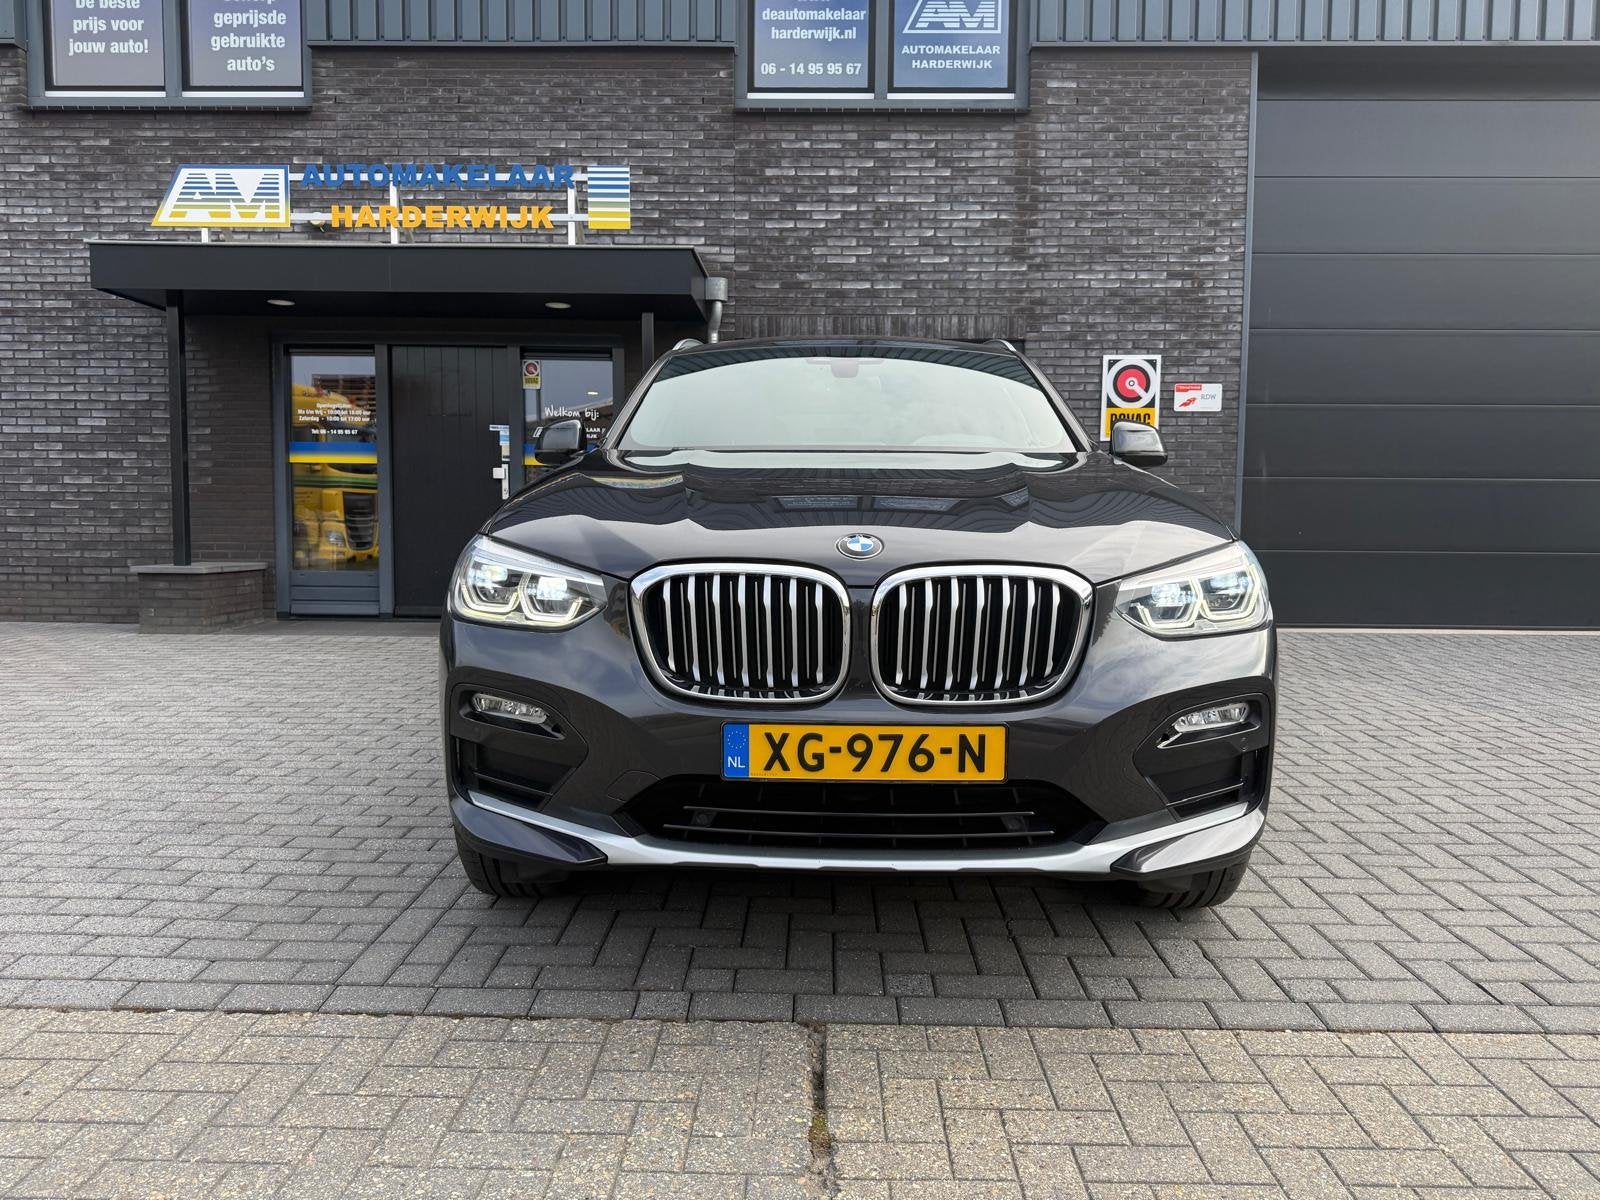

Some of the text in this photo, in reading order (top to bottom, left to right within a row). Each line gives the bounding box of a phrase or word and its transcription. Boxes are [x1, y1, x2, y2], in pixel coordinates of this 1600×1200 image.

[213, 10, 287, 28] geprijsde
[762, 8, 866, 21] deautomakelaar
[73, 17, 145, 34] prijs voor
[771, 26, 857, 41] harderwijk.nl
[69, 38, 149, 56] jouw auto!
[211, 33, 286, 51] gebruikte
[901, 45, 1001, 55] AUTOMAKELAAR
[761, 63, 777, 75] 06
[790, 63, 805, 75] 14
[807, 63, 824, 75] 95
[827, 63, 843, 75] 95
[845, 63, 862, 75] 67
[911, 59, 993, 69] HARDERWIJK
[301, 163, 575, 189] AUTOMAKELAAR
[331, 203, 554, 229] HARDERWIJK
[544, 405, 599, 420] Welkom bij:
[727, 732, 986, 773] NL XG-976-N
